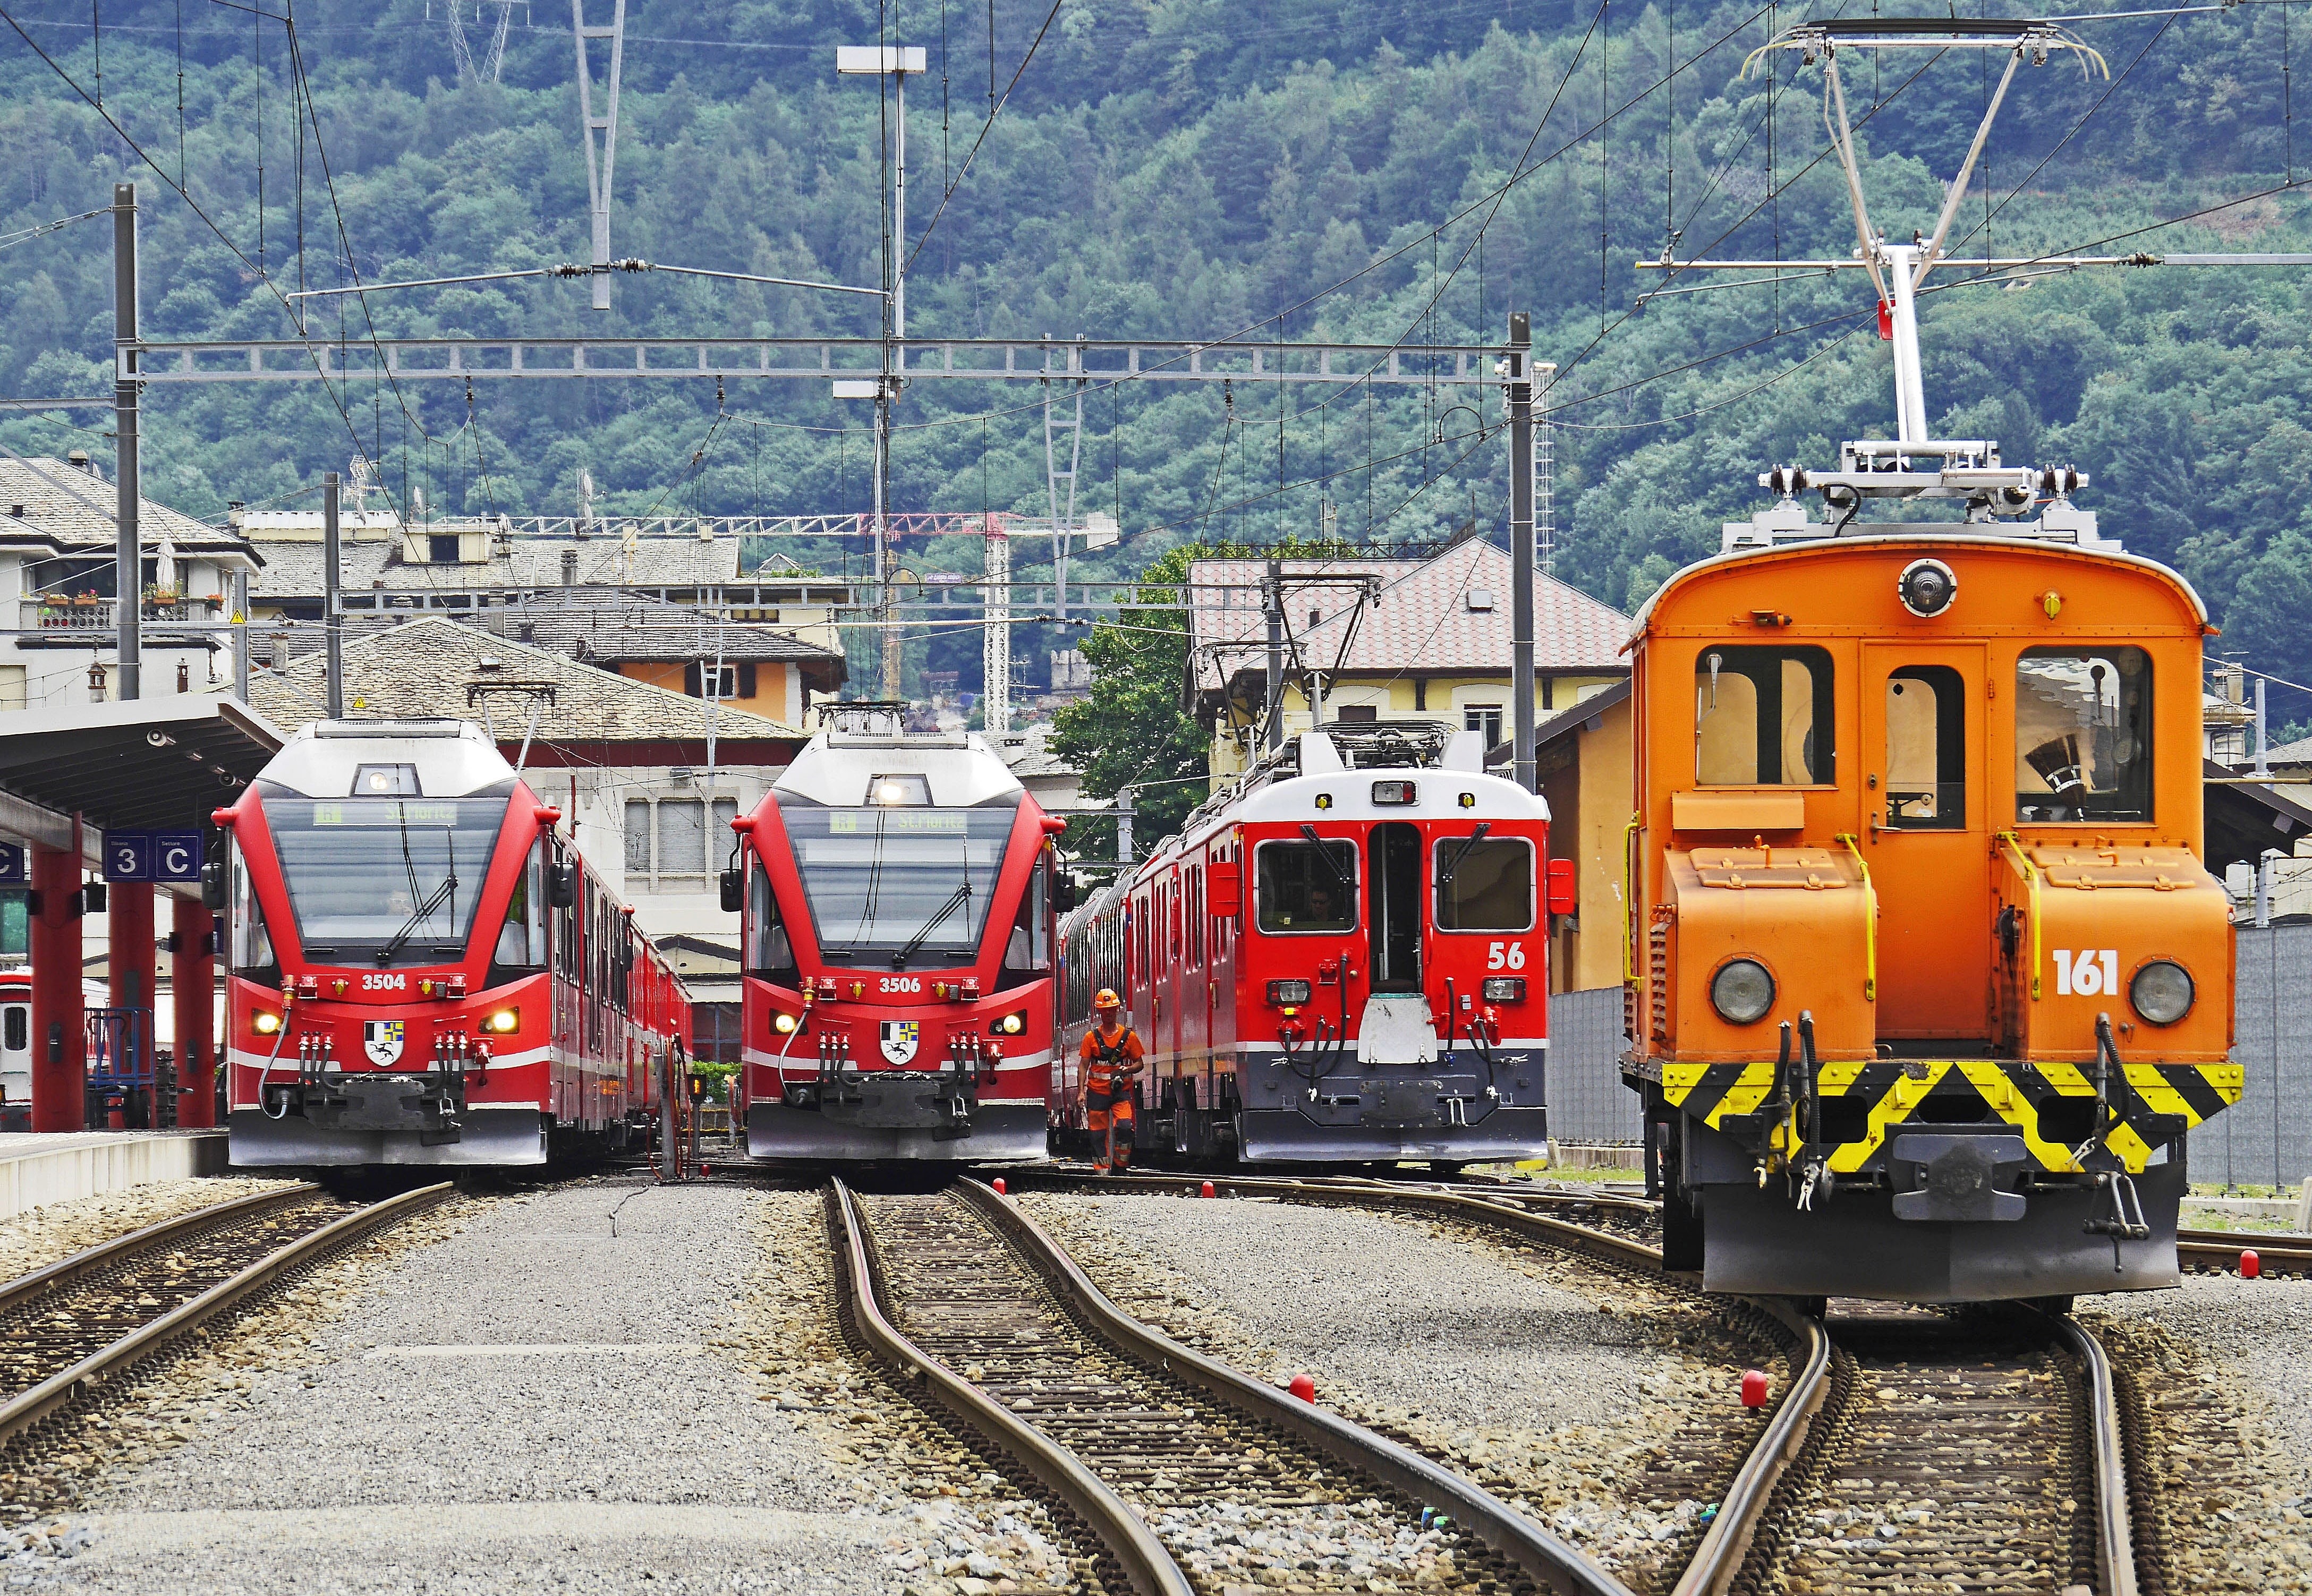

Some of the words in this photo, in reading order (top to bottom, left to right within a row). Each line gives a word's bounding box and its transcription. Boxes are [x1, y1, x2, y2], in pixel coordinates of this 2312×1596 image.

[898, 813, 965, 829] St.Moritz
[117, 848, 136, 873] 3
[166, 848, 188, 873] C
[1488, 942, 1525, 970] 56
[362, 974, 405, 990] 3504
[879, 977, 921, 993] 3506
[2053, 949, 2119, 996] 161
